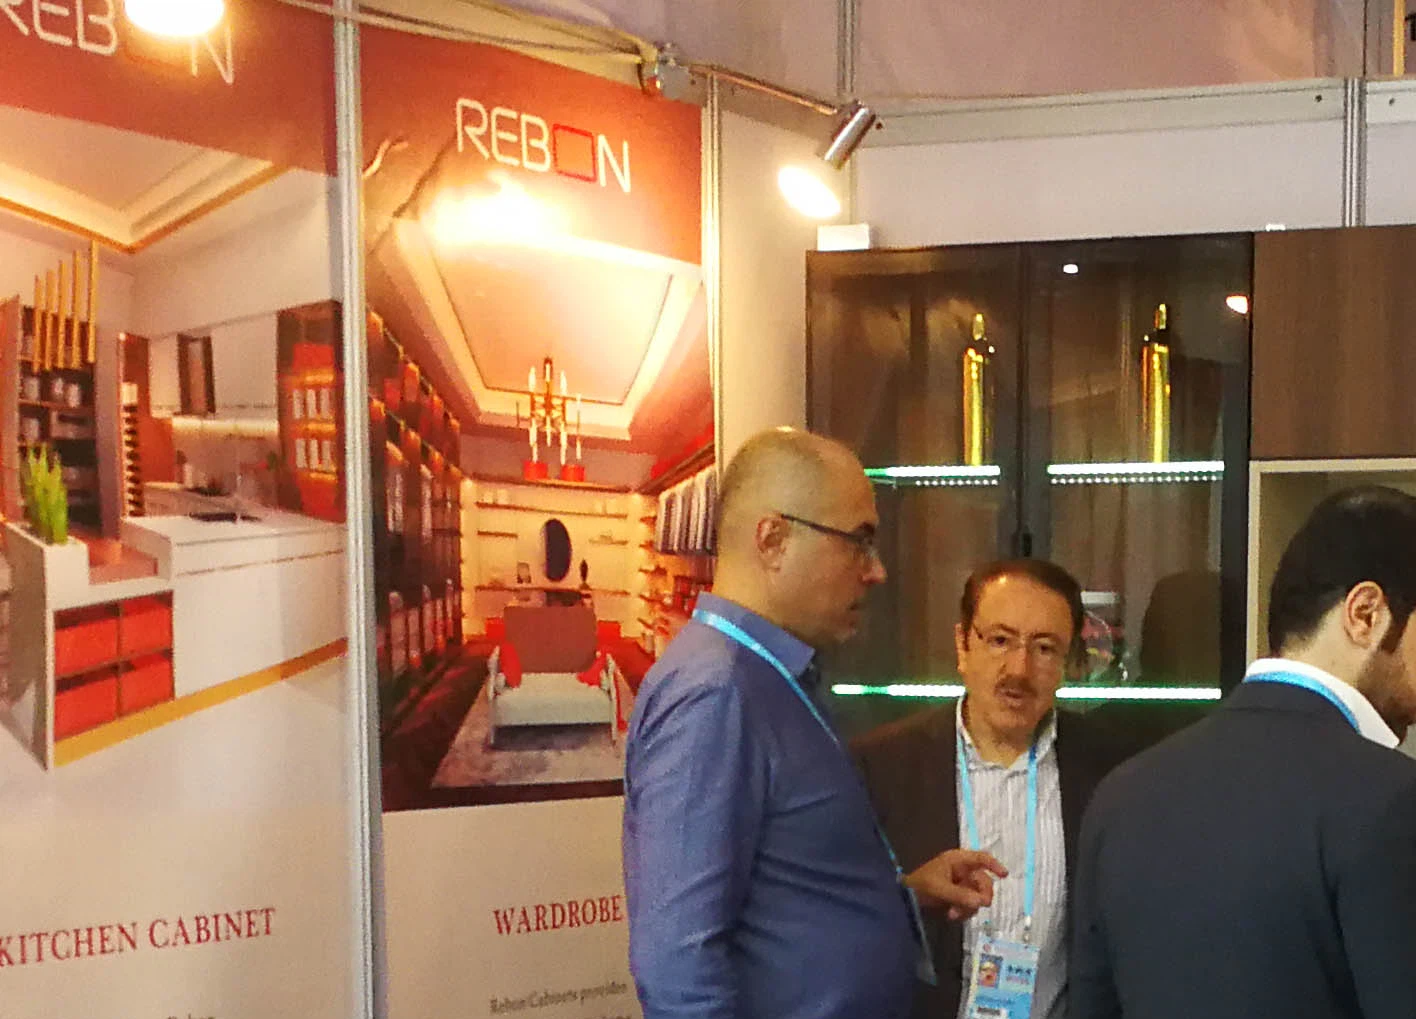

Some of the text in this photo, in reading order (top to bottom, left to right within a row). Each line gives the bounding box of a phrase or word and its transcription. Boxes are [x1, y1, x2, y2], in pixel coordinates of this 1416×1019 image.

[456, 97, 632, 193] REBON
[0, 907, 276, 967] KITCHEN CABINET
[493, 894, 624, 935] WARDROBE
